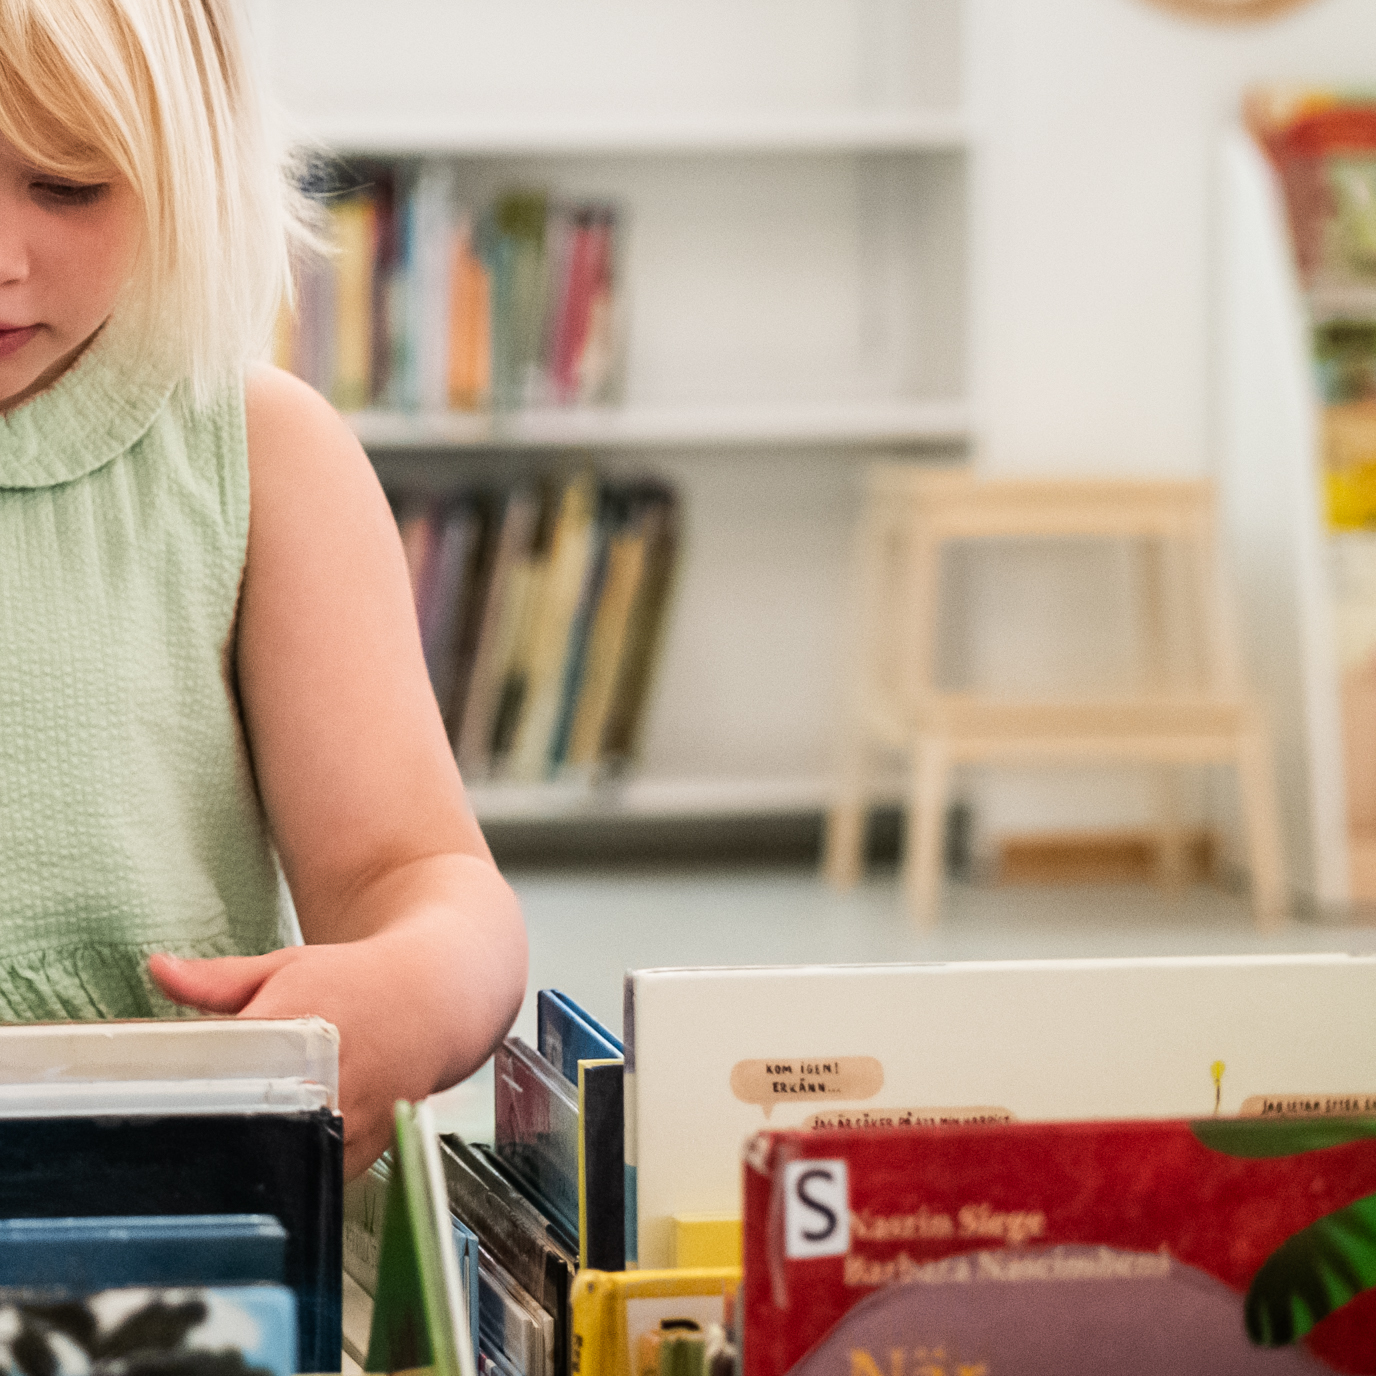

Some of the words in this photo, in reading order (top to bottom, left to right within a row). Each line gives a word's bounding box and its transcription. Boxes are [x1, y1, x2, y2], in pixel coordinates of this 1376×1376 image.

[765, 1063, 793, 1075] KOM
[800, 1061, 839, 1075] IGEN!
[796, 1169, 837, 1242] S
[957, 1202, 1047, 1249] Siege
[844, 1252, 970, 1286] Barbara
